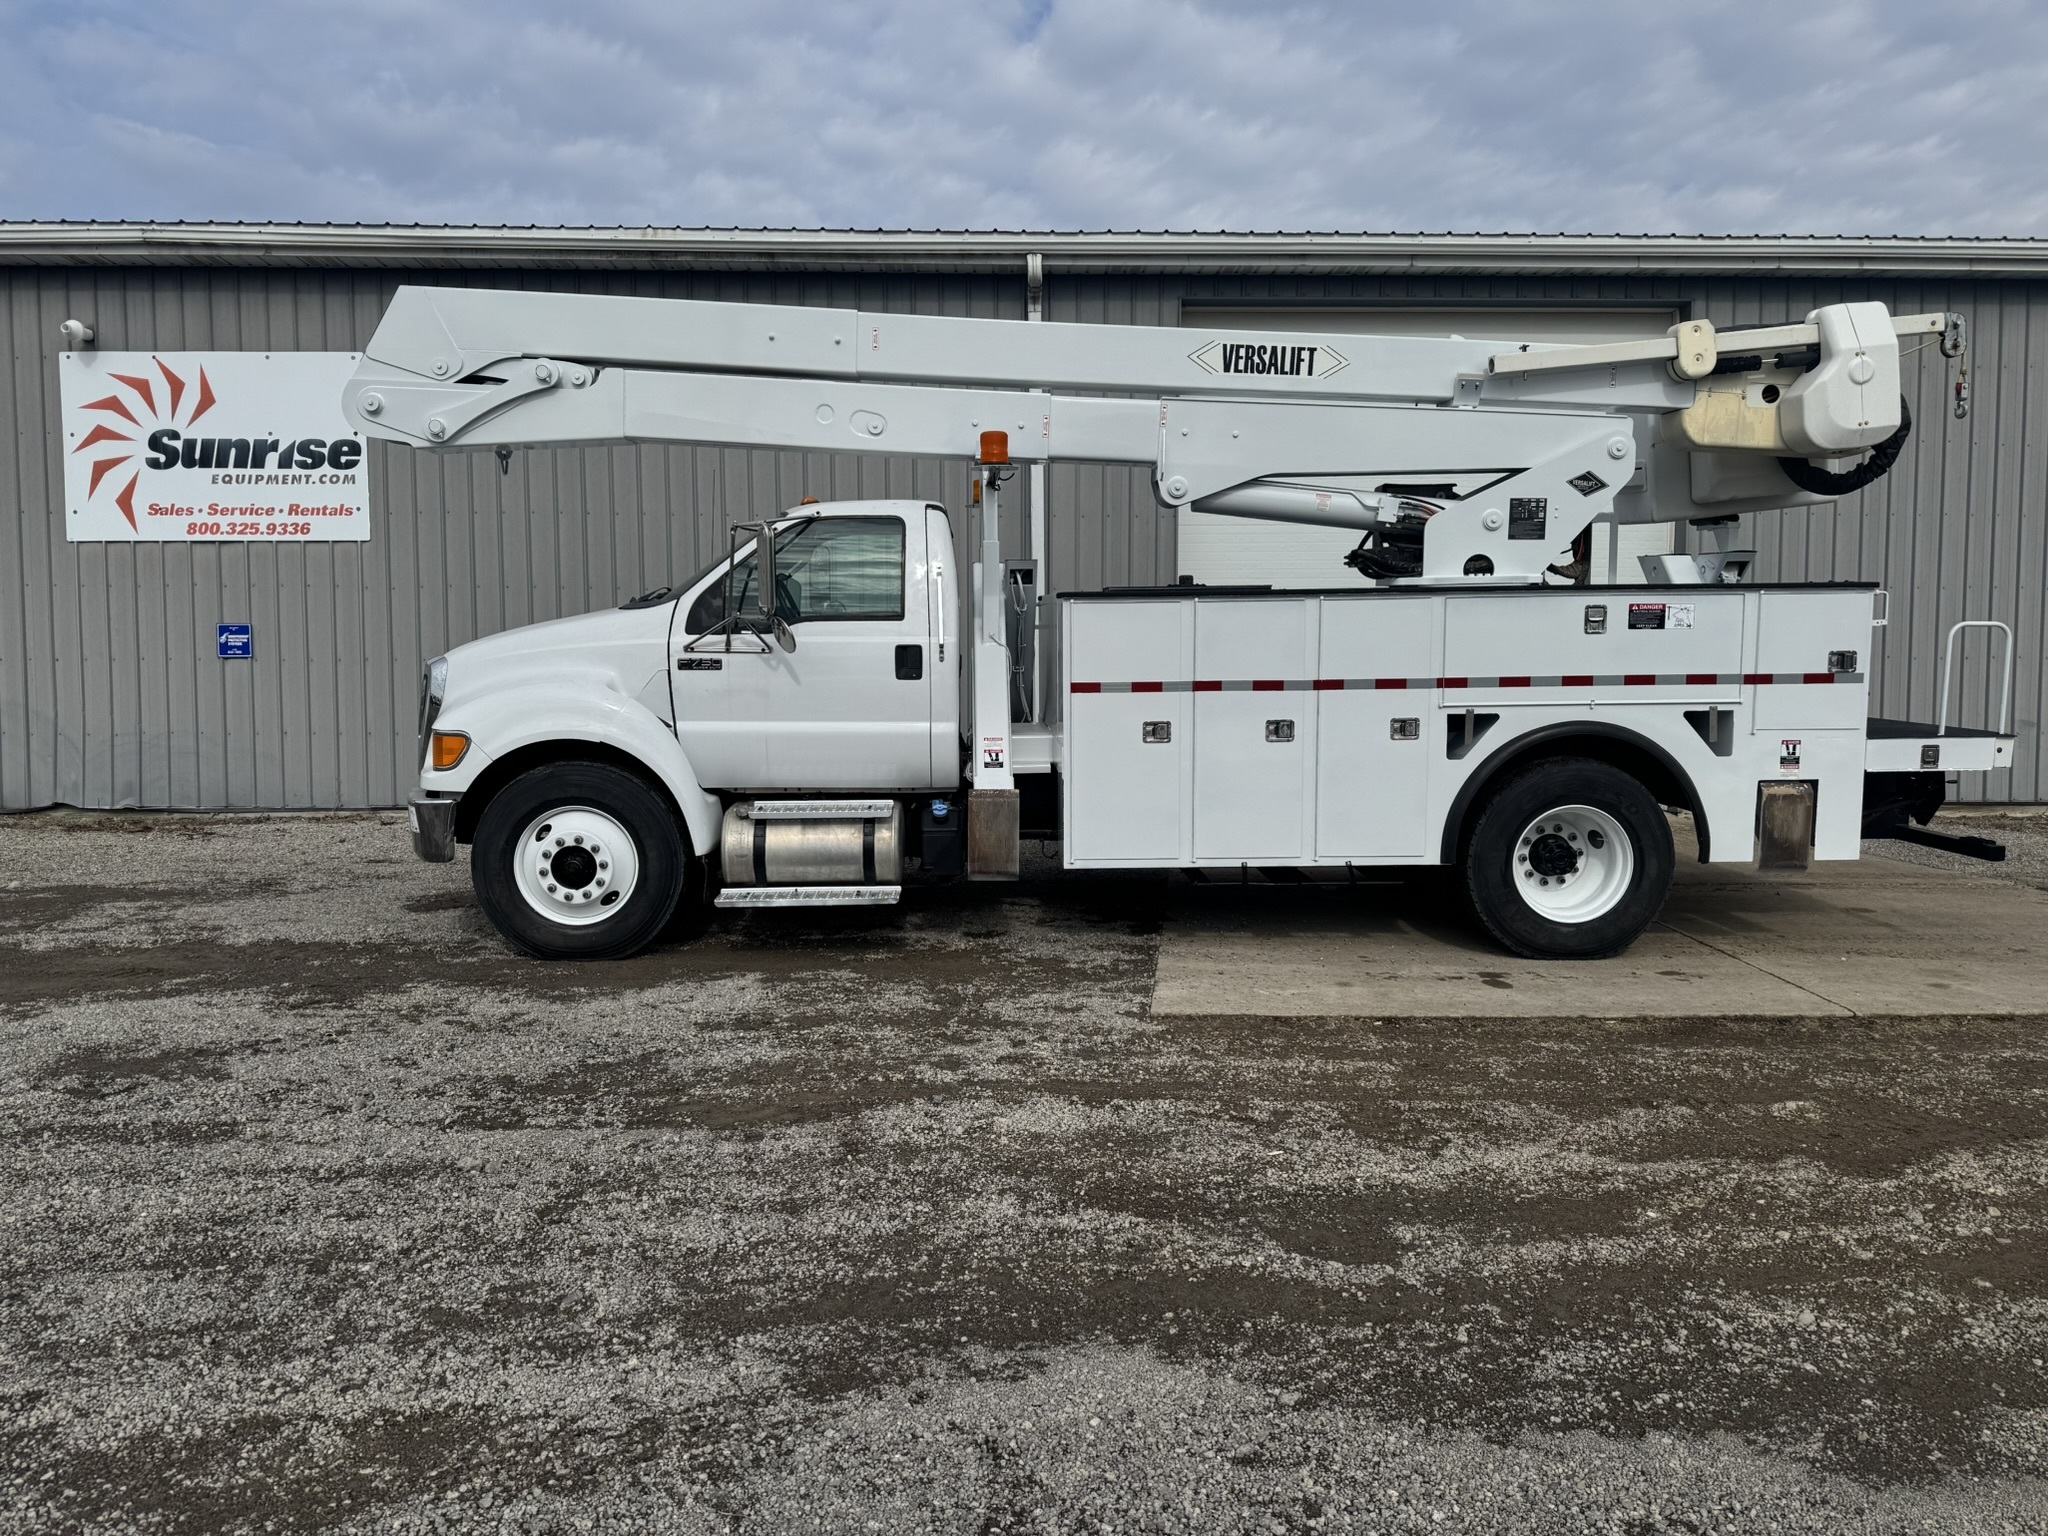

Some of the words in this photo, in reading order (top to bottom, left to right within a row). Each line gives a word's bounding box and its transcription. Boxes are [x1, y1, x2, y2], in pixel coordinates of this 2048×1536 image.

[1222, 343, 1317, 377] VERSALIFT
[145, 428, 362, 470] Sunrise
[211, 474, 357, 485] EQUIPMENT.COM
[1572, 479, 1596, 487] VERSALIFT
[147, 503, 194, 516] Sales
[207, 503, 275, 516] Service
[287, 503, 354, 516] Rentals
[186, 522, 311, 536] 800.325.9336
